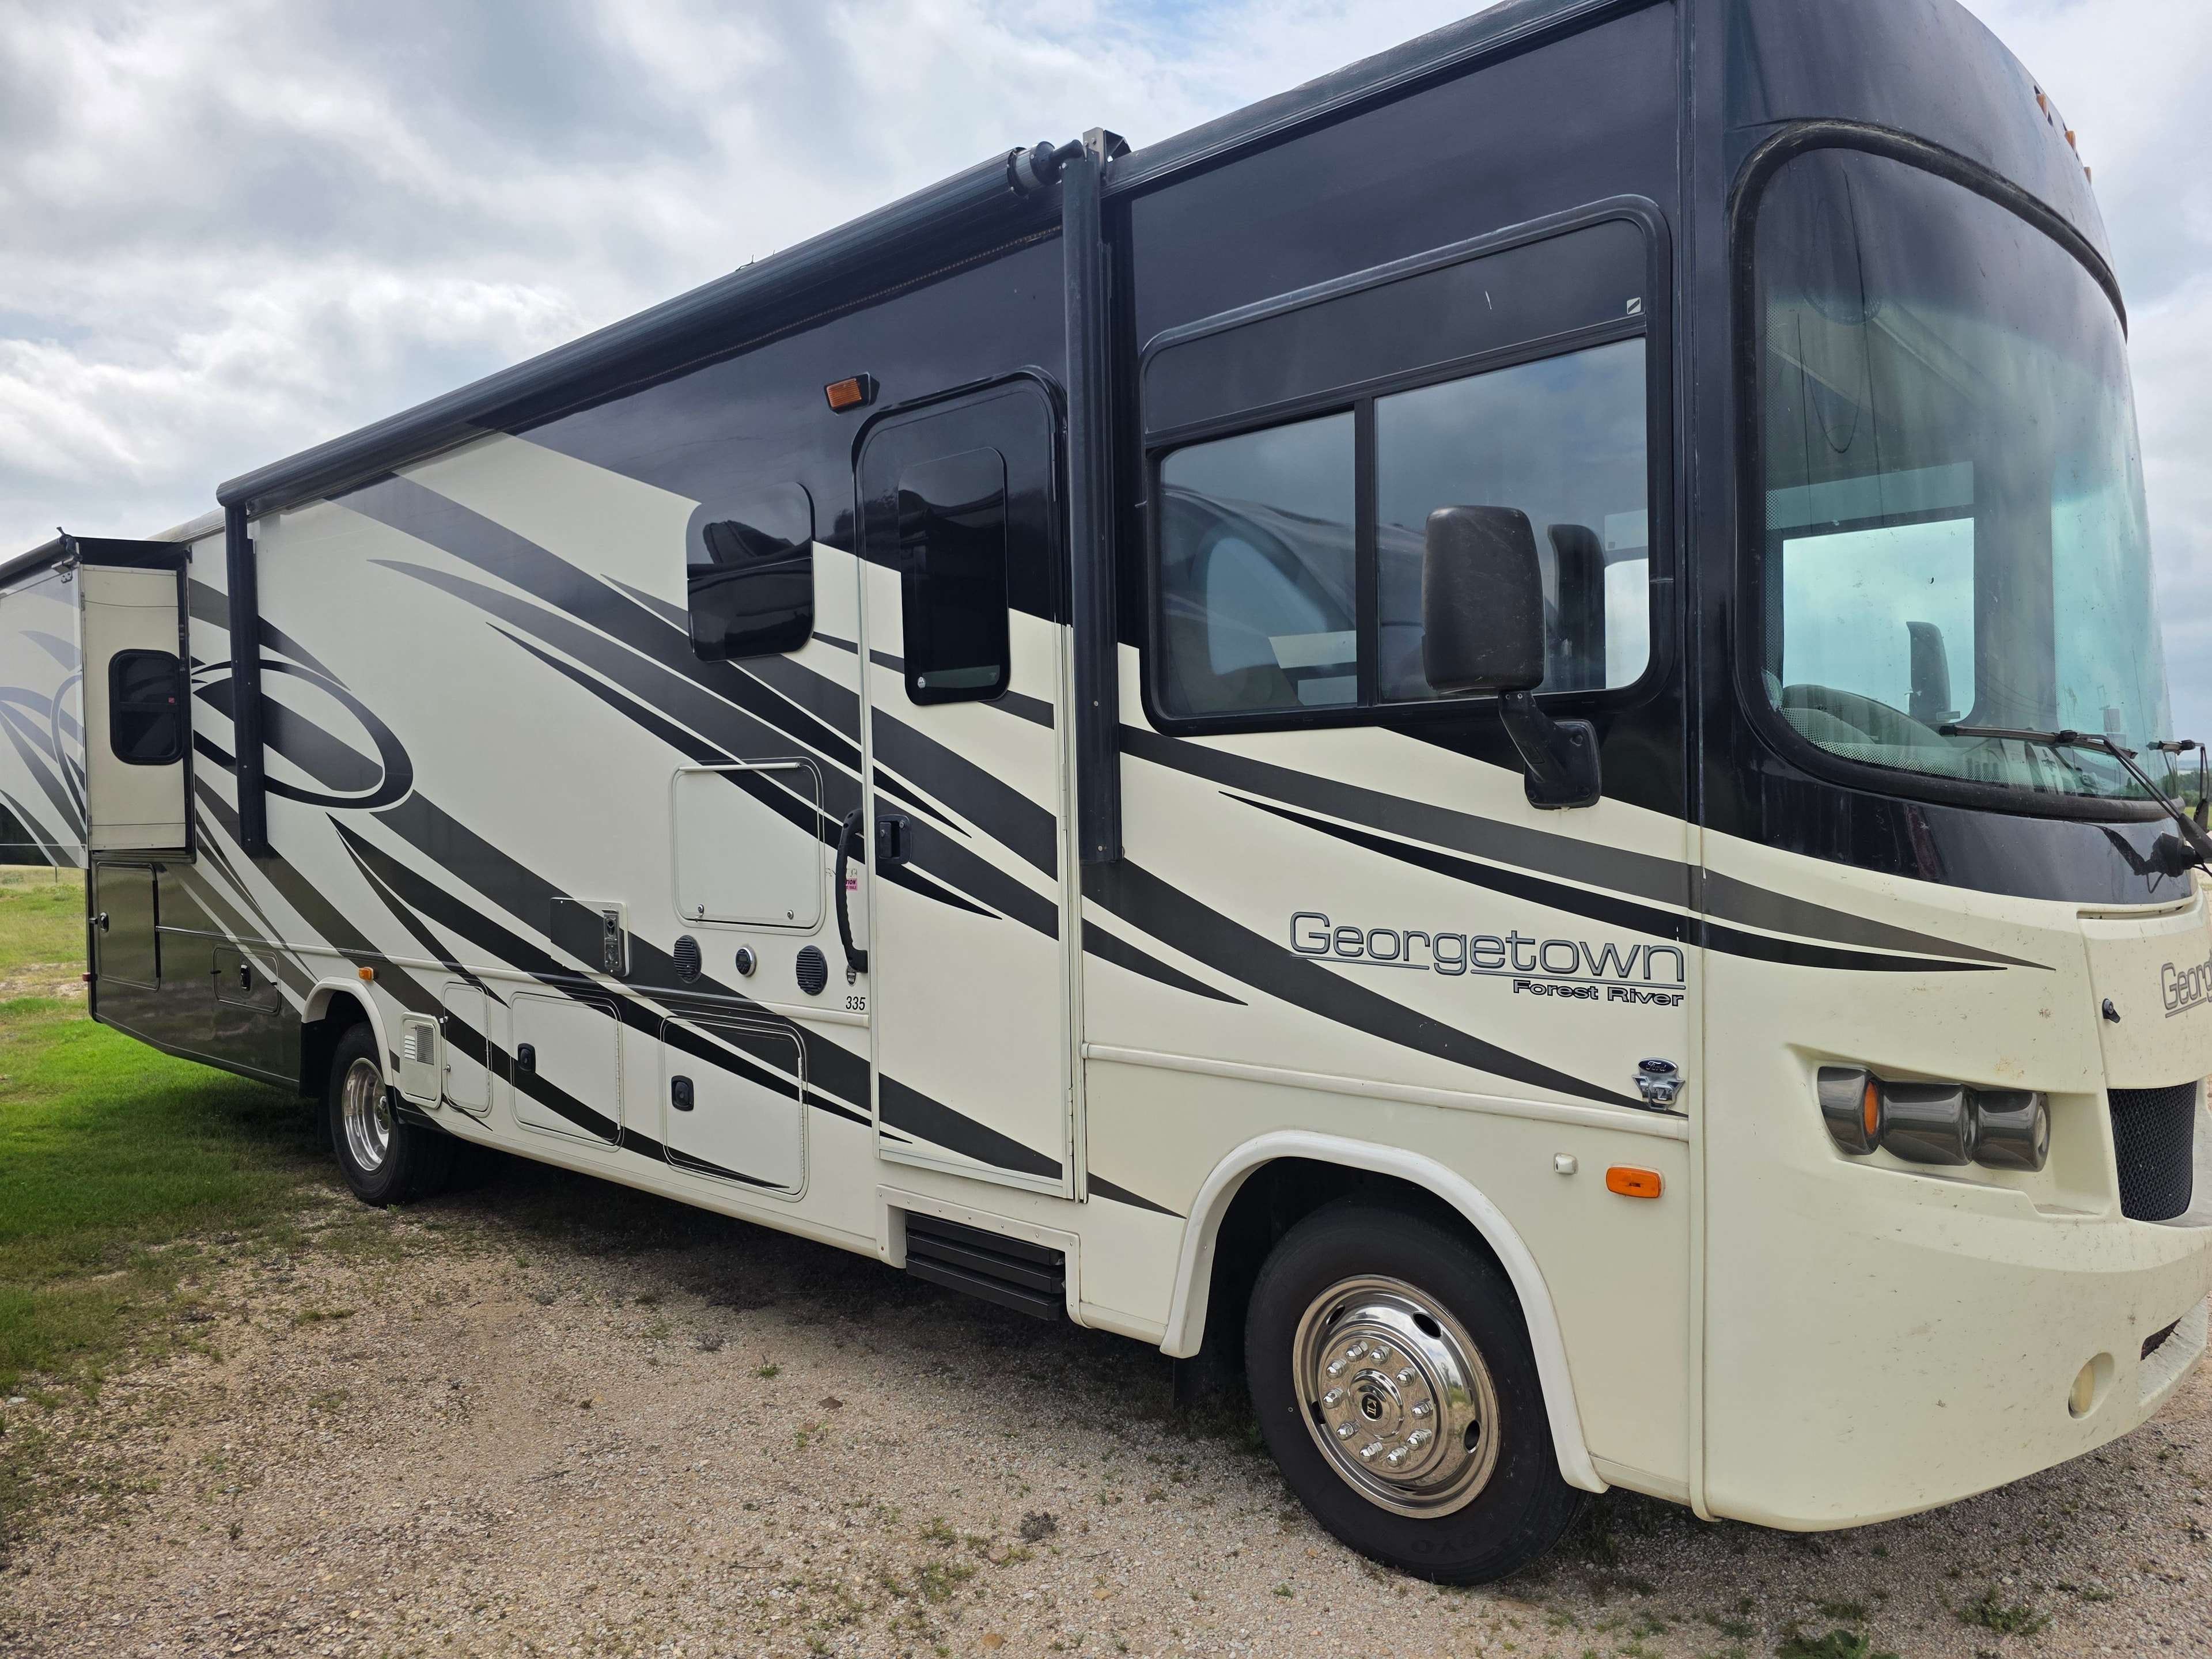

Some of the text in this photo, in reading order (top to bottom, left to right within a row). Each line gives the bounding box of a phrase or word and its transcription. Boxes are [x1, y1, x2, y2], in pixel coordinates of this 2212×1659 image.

[1290, 911, 1685, 982] Georgetown
[846, 995, 866, 1011] 335
[1513, 979, 1684, 1007] Forest River
[1645, 1060, 1667, 1072] Ford
